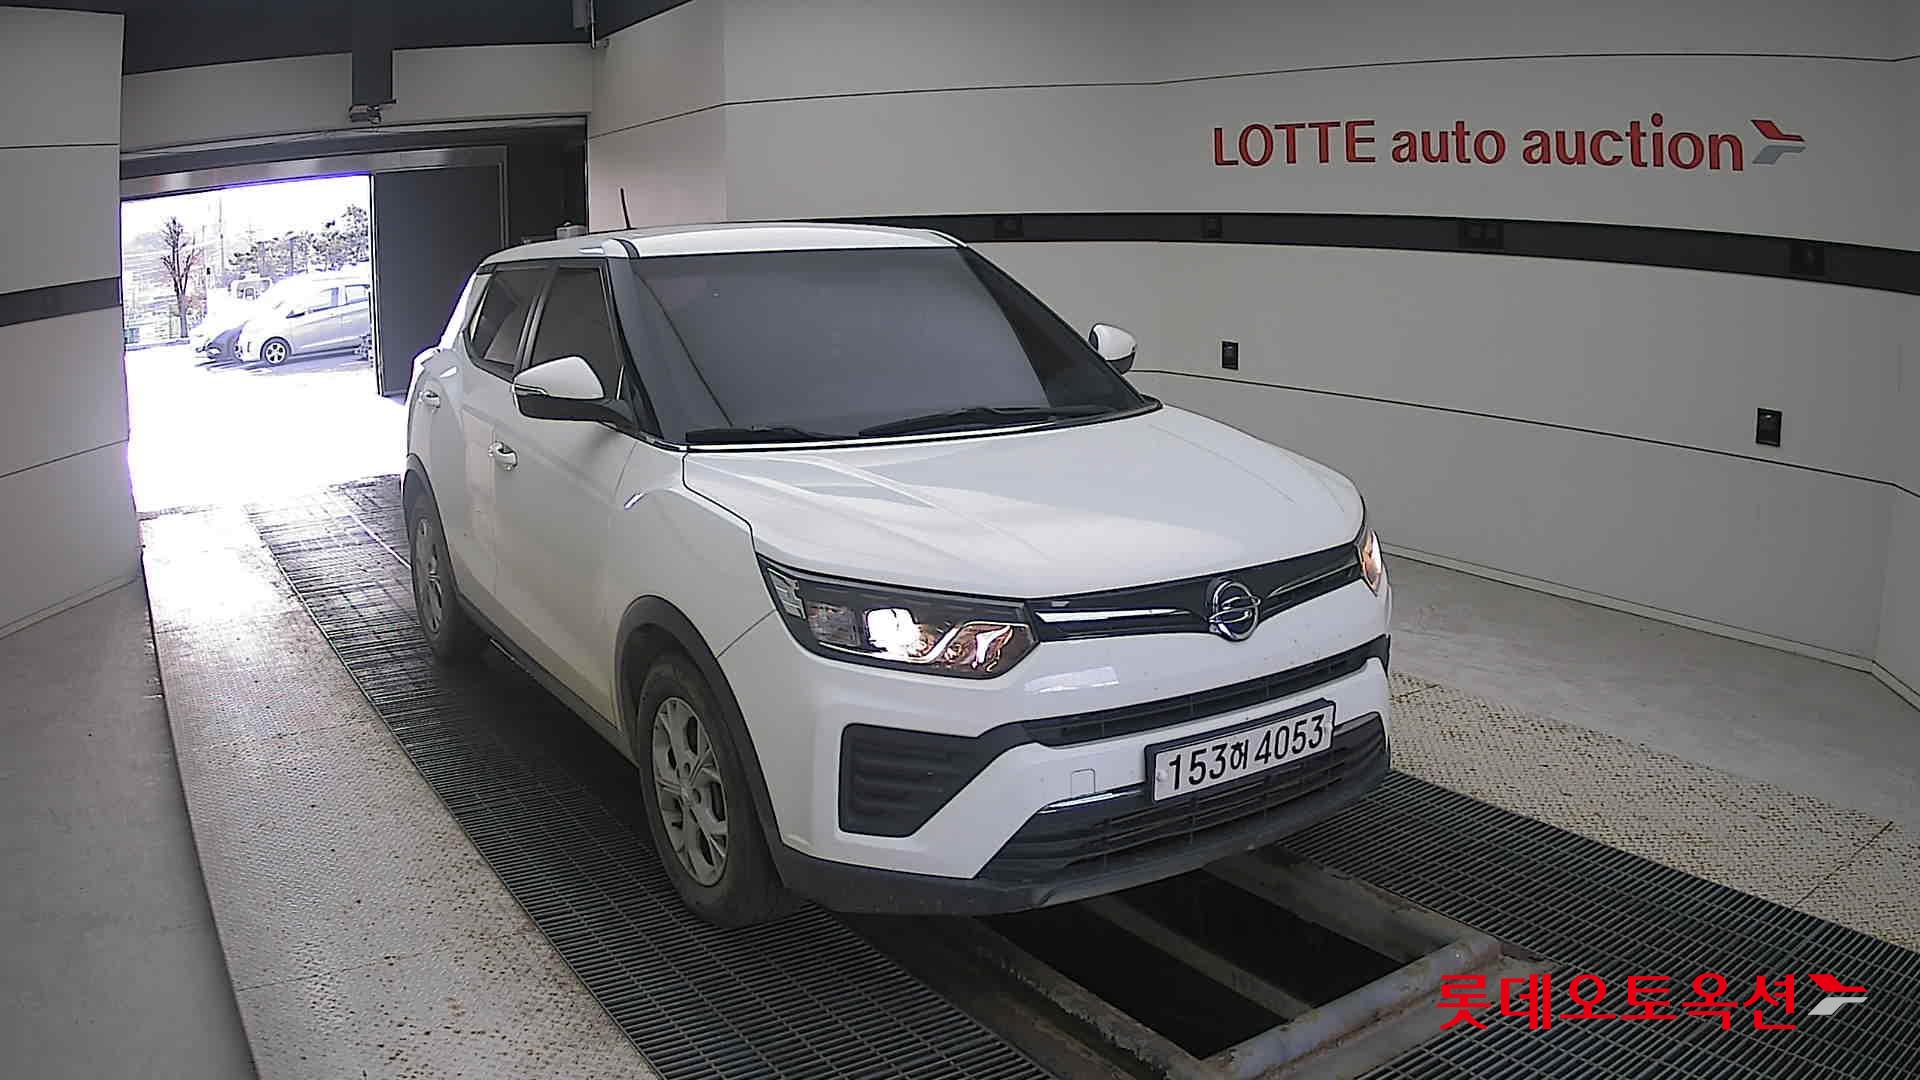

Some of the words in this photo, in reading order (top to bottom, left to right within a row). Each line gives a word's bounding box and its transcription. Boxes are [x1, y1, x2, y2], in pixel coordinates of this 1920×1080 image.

[1213, 120, 1376, 167] LOTTE
[1391, 120, 1506, 165] auto
[1522, 113, 1744, 172] auction
[1168, 738, 1249, 791] 153허
[1254, 713, 1325, 764] 4053
